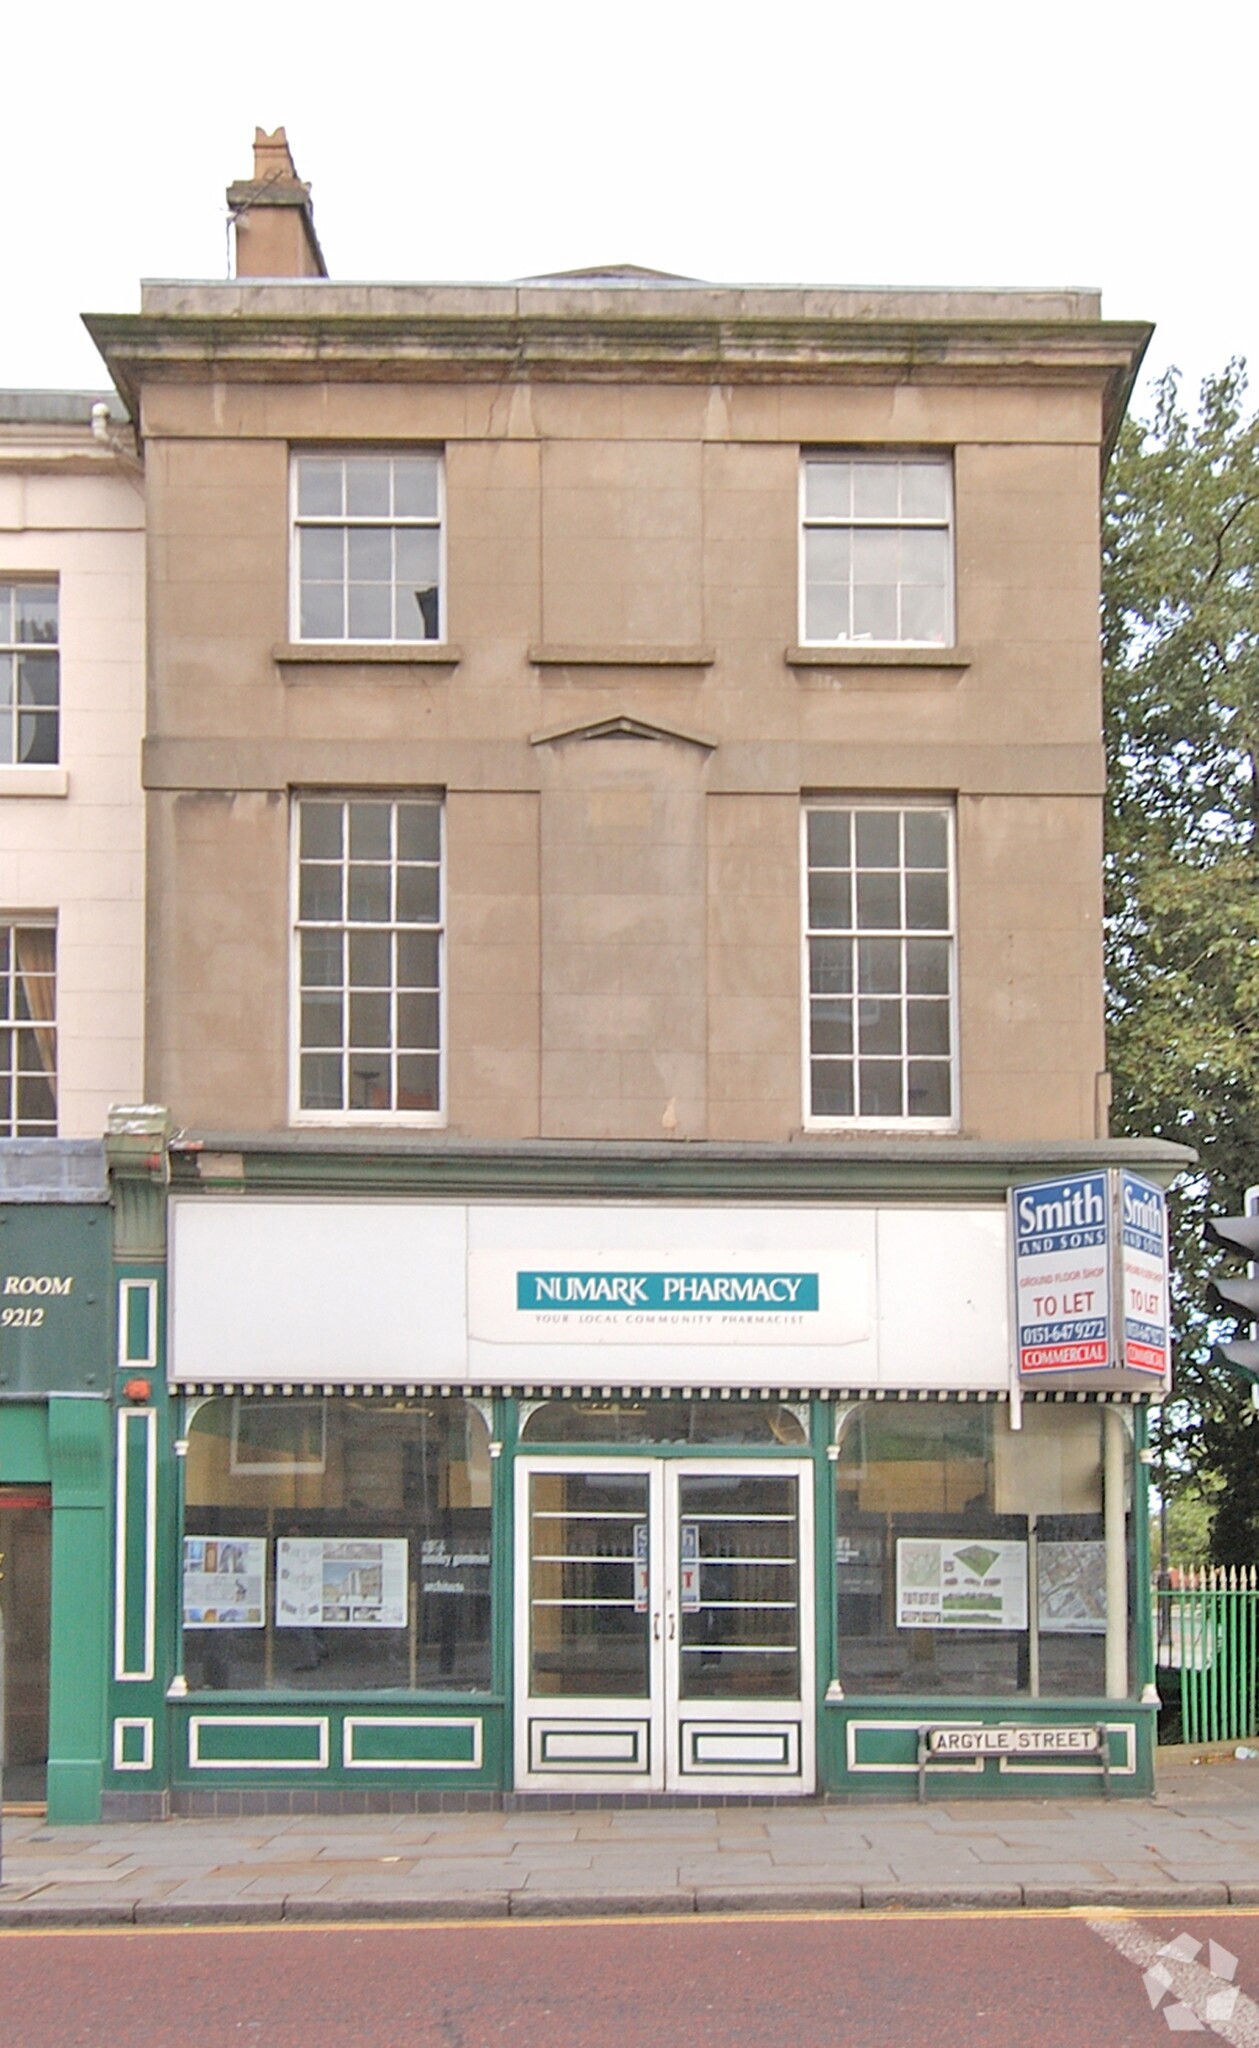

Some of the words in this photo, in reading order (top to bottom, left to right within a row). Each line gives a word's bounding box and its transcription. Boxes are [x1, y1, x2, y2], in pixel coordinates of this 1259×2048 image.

[1019, 1183, 1104, 1235] Smith
[1124, 1184, 1162, 1236] Smith
[1021, 1238, 1053, 1255] AND
[1060, 1229, 1105, 1249] SONS
[3, 1276, 74, 1296] ROOM
[1020, 1275, 1053, 1287] GROUND
[1055, 1270, 1081, 1282] FLOOR
[1083, 1266, 1104, 1279] SHOP
[535, 1277, 649, 1305] NUMARK
[662, 1277, 802, 1302] PHARMACY
[1131, 1288, 1142, 1311] TO
[1145, 1292, 1159, 1315] LET
[1033, 1296, 1057, 1317] TO
[1063, 1291, 1095, 1314] LET
[0, 1307, 45, 1327] 9212
[535, 1314, 569, 1325] YOUR
[579, 1314, 619, 1325] LOCAL
[625, 1314, 713, 1325] COMMUNITY
[721, 1315, 805, 1325] PHARMACIST
[1075, 1320, 1105, 1340] 9272
[1024, 1344, 1105, 1367] COMMERCIAL
[936, 1732, 1009, 1749] ARGYLE
[1018, 1731, 1092, 1748] STREET
